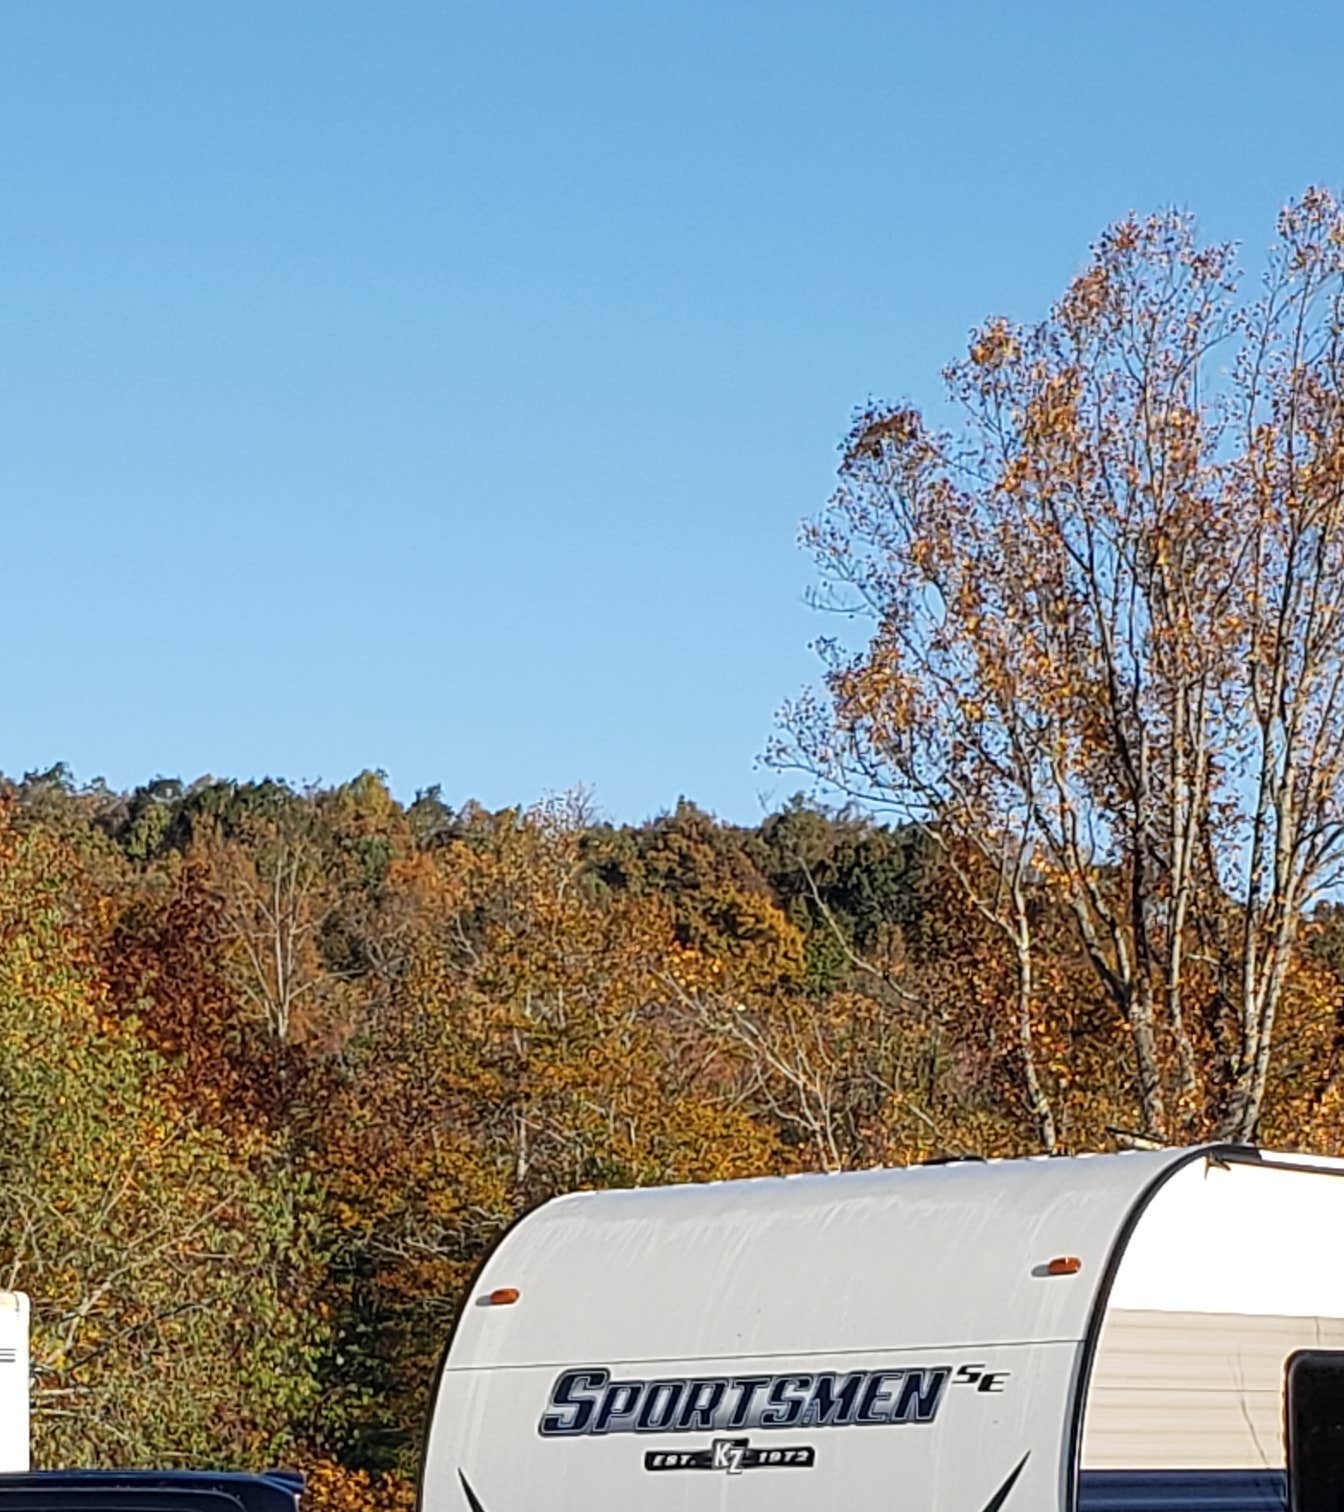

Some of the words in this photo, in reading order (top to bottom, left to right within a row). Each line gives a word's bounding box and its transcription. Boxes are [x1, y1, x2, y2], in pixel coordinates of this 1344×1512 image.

[539, 1367, 952, 1437] SPORTSMEN
[653, 1455, 697, 1467] EST.
[758, 1451, 809, 1463] 1972
